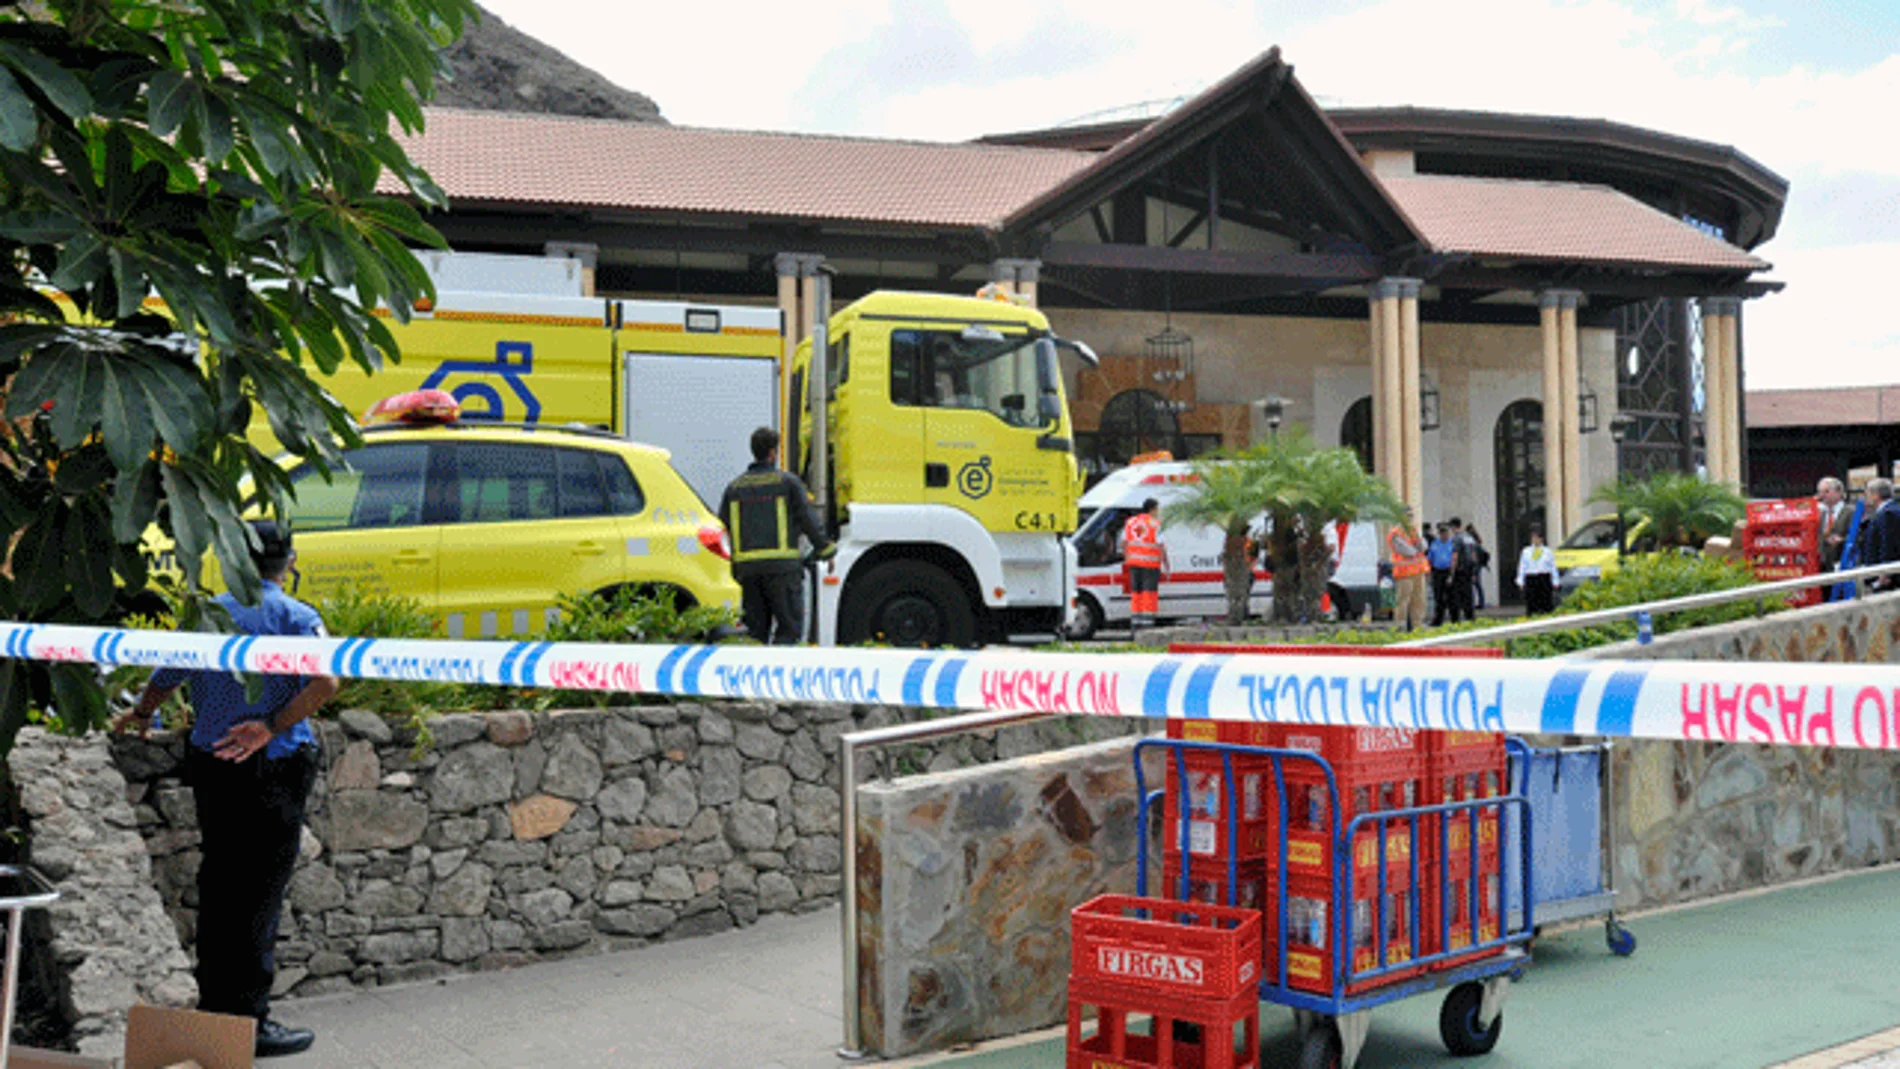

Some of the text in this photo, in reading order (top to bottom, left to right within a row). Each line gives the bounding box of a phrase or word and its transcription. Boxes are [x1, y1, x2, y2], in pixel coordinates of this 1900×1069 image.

[1015, 511, 1056, 530] C4.1
[980, 670, 1122, 717] NO PASAR
[1239, 674, 1505, 732] POLICIA LOCAL
[1680, 682, 1900, 749] O PASAR
[1099, 947, 1203, 985] FIRGAS
